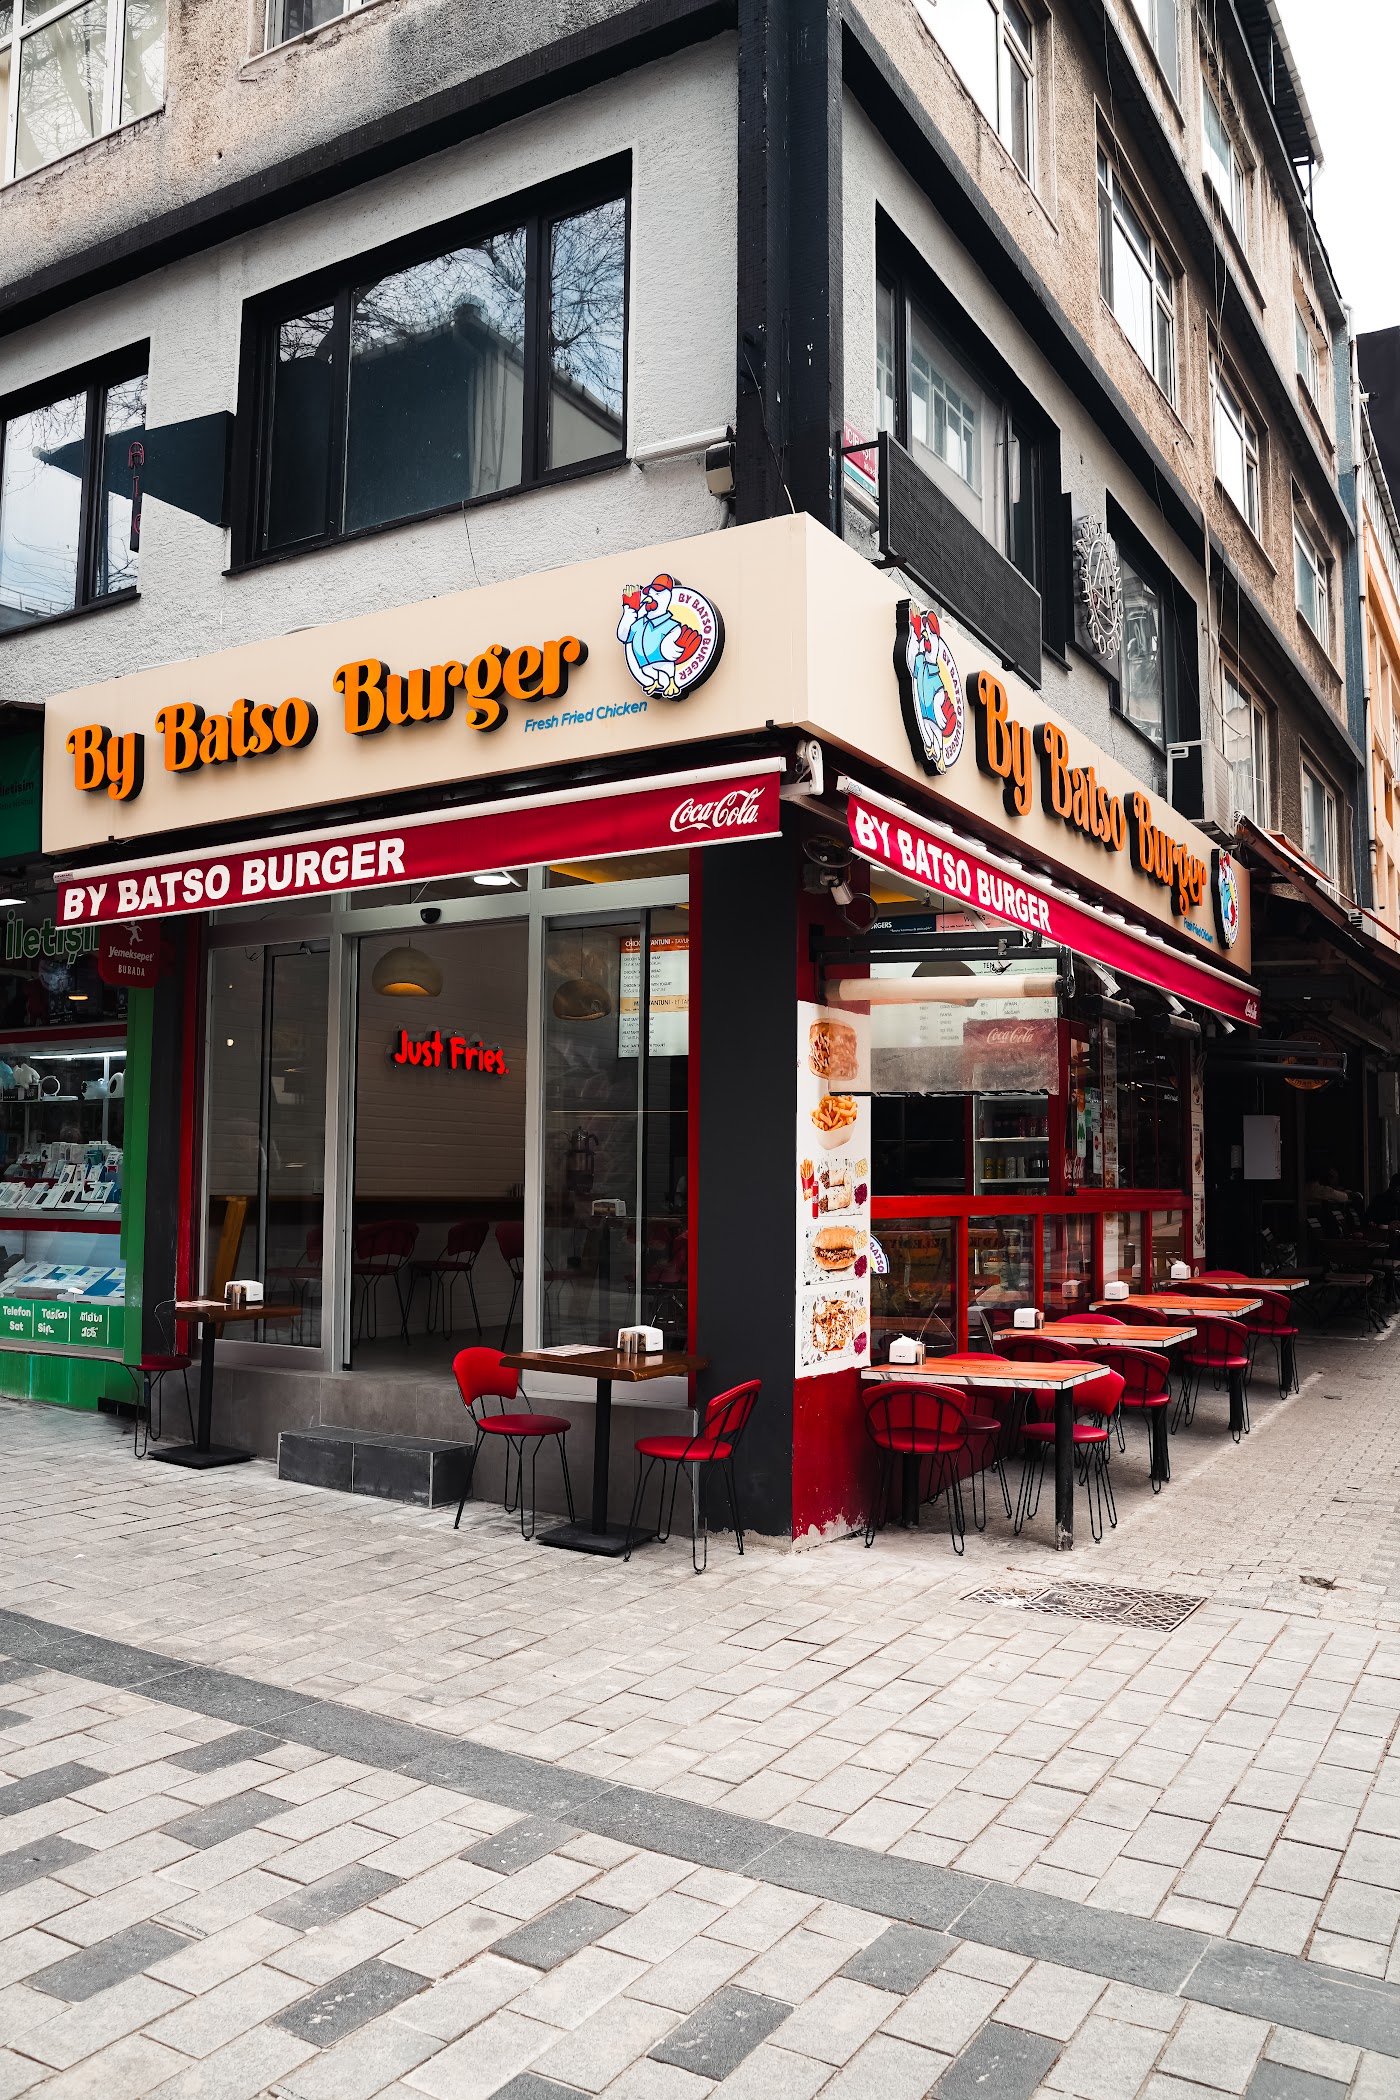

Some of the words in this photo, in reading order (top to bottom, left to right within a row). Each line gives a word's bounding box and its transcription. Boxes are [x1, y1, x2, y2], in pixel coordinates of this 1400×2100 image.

[678, 593, 693, 604] BY
[691, 599, 713, 635] BATSO
[678, 637, 712, 681] BURGER
[66, 723, 138, 801] By
[154, 697, 312, 772] Batso
[332, 635, 582, 731] Burger
[524, 715, 559, 733] Fresh
[561, 708, 595, 727] Fried
[596, 701, 648, 719] Chicken
[669, 787, 765, 833] Coca-Cola
[977, 669, 1033, 817] By
[1043, 721, 1126, 852] Batso
[1133, 790, 1207, 917] Burger
[63, 883, 107, 921] BY
[117, 864, 231, 914] BATSO
[241, 837, 406, 896] BURGER
[855, 805, 891, 858] BY
[896, 828, 972, 897] BATSO
[976, 867, 1053, 934] BURGER
[117, 964, 146, 977] BURADA
[395, 1029, 444, 1067] Just
[449, 1036, 510, 1074] Fries.
[2, 1305, 31, 1317] Telefon
[9, 1320, 24, 1331] Sat
